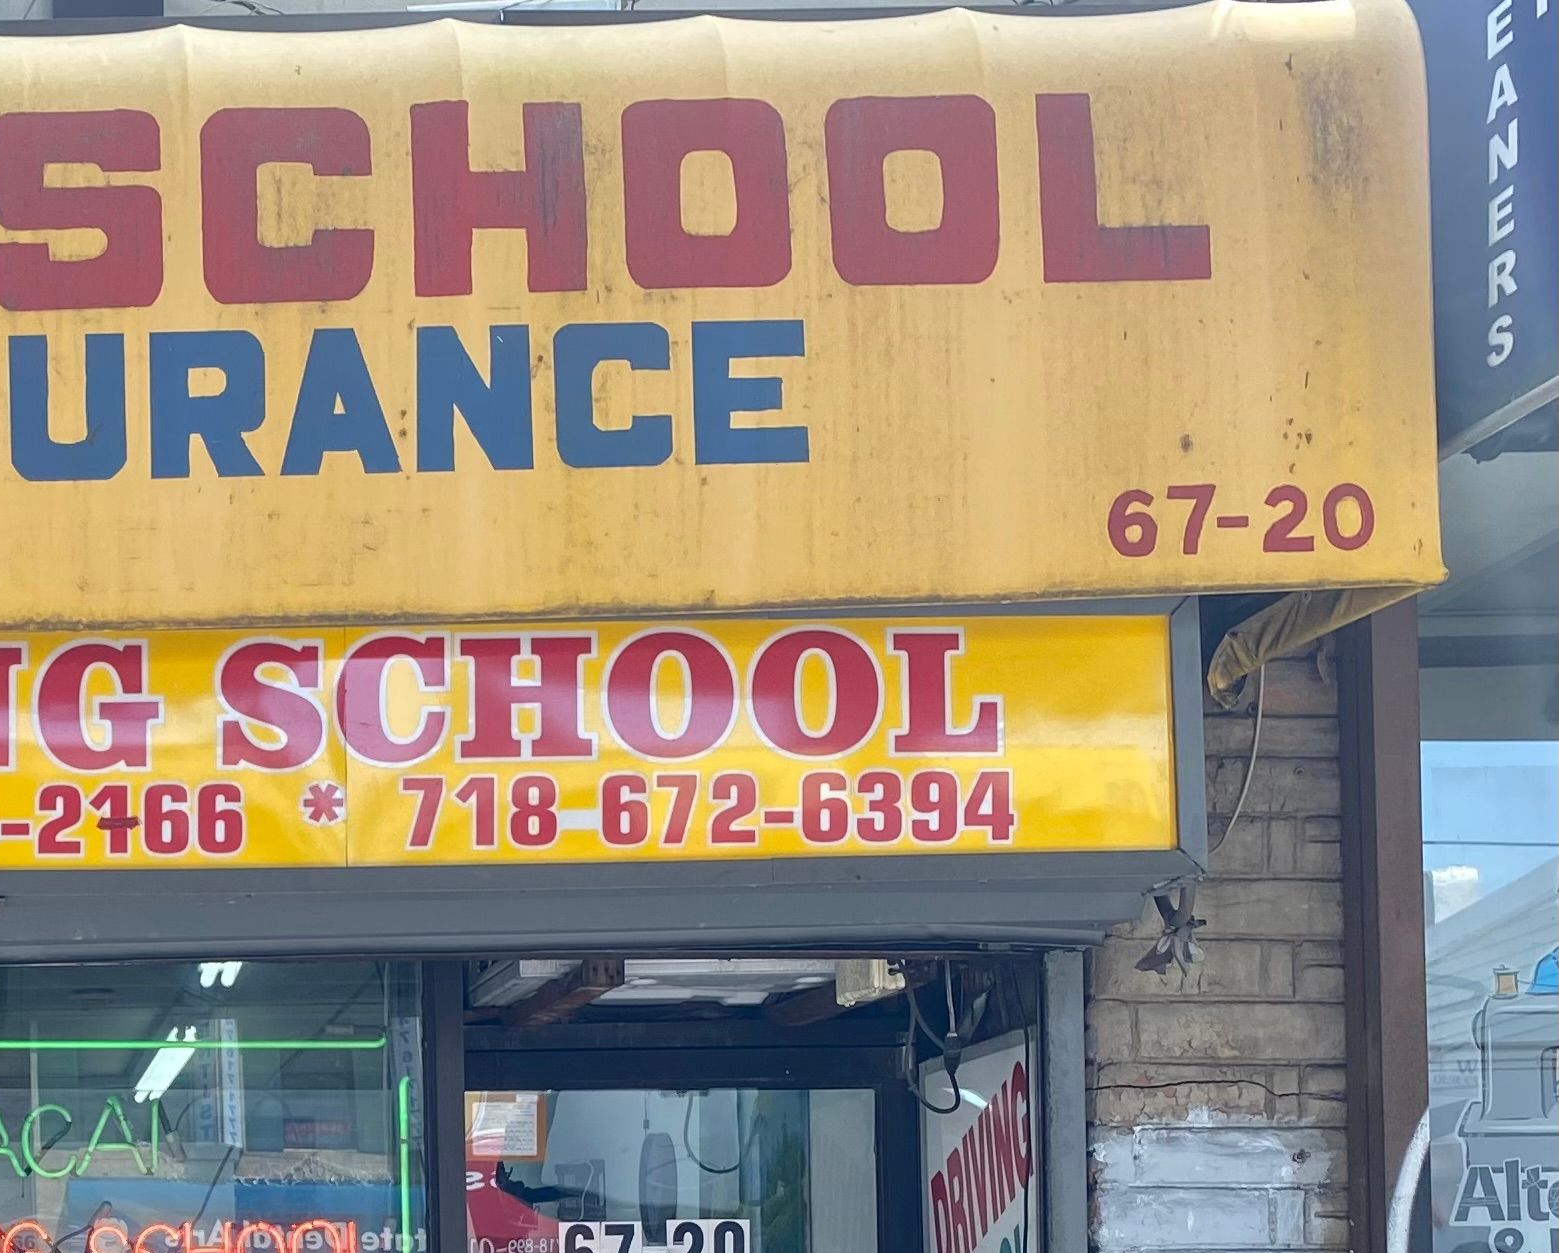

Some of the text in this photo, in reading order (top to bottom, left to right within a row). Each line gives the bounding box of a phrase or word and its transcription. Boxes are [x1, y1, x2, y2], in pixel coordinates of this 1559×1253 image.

[1107, 482, 1376, 558] 67-20
[215, 626, 1004, 770] SCHOOL
[400, 769, 1018, 850] 718-672-6394
